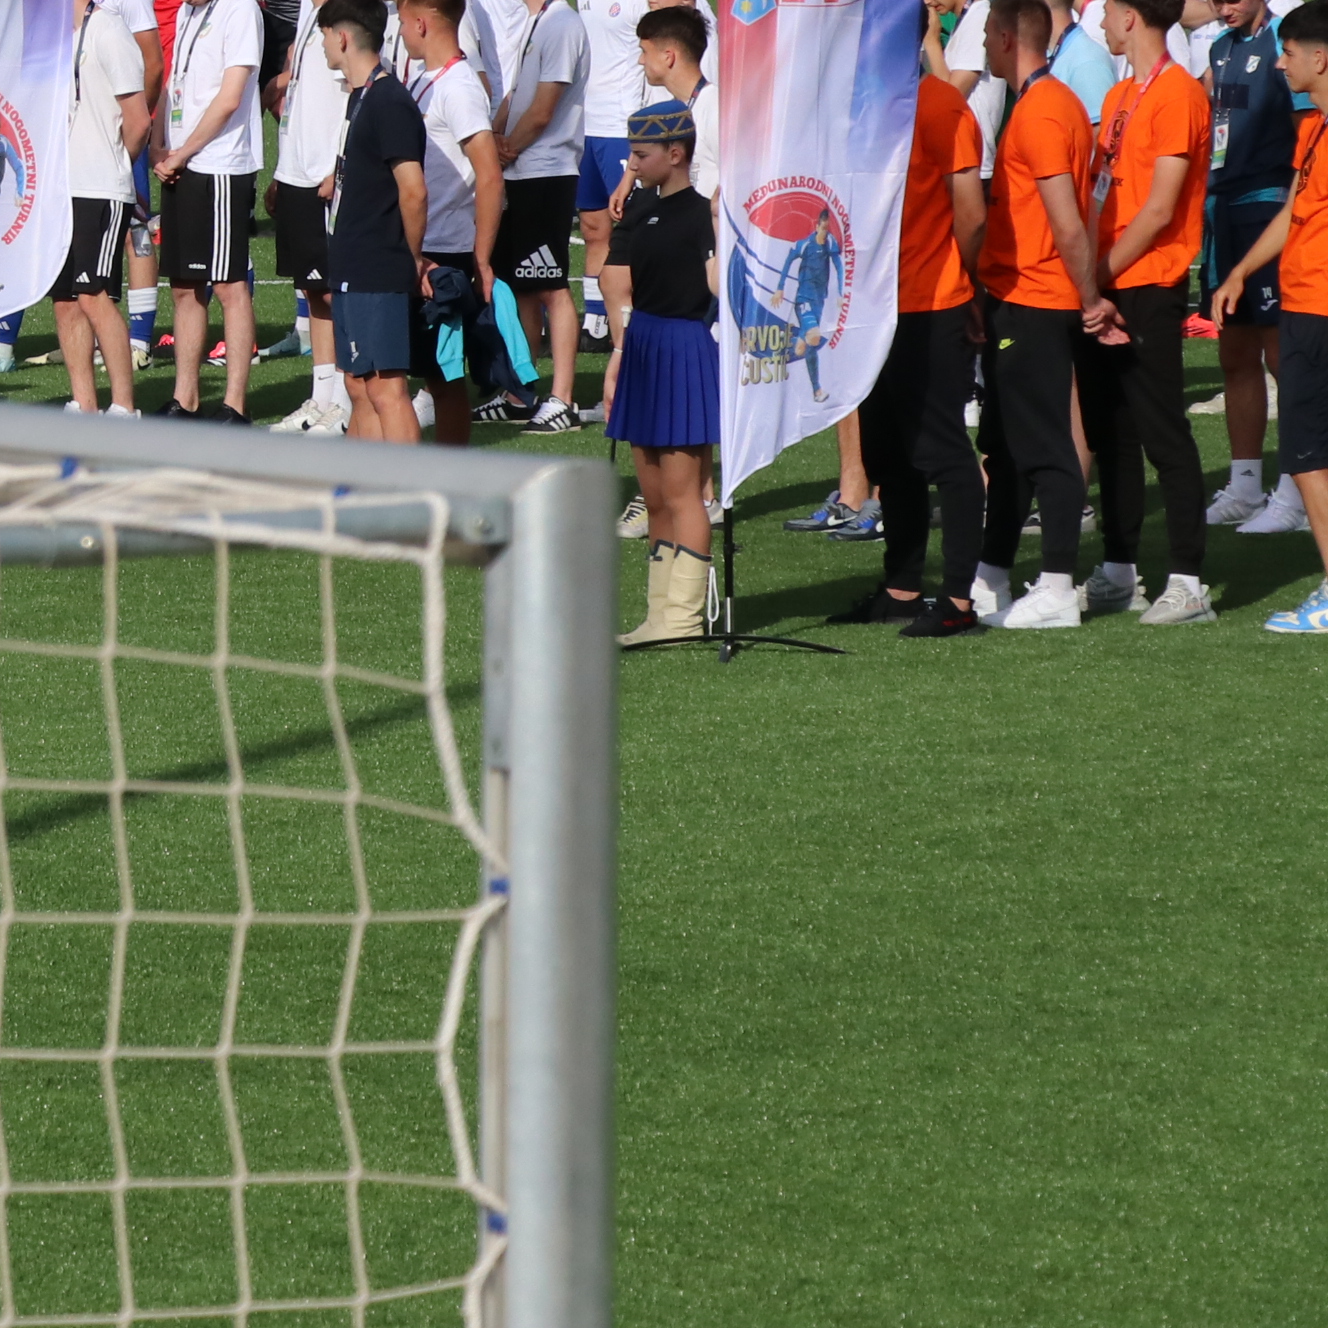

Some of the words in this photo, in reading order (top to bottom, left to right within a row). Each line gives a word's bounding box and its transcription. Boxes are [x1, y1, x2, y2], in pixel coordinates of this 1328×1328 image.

[1, 96, 37, 191] NOGOMETNI
[1, 193, 36, 246] TURNIR
[830, 194, 856, 288] NOGOMETNI
[515, 265, 563, 279] adidas
[828, 290, 853, 350] TURNIR
